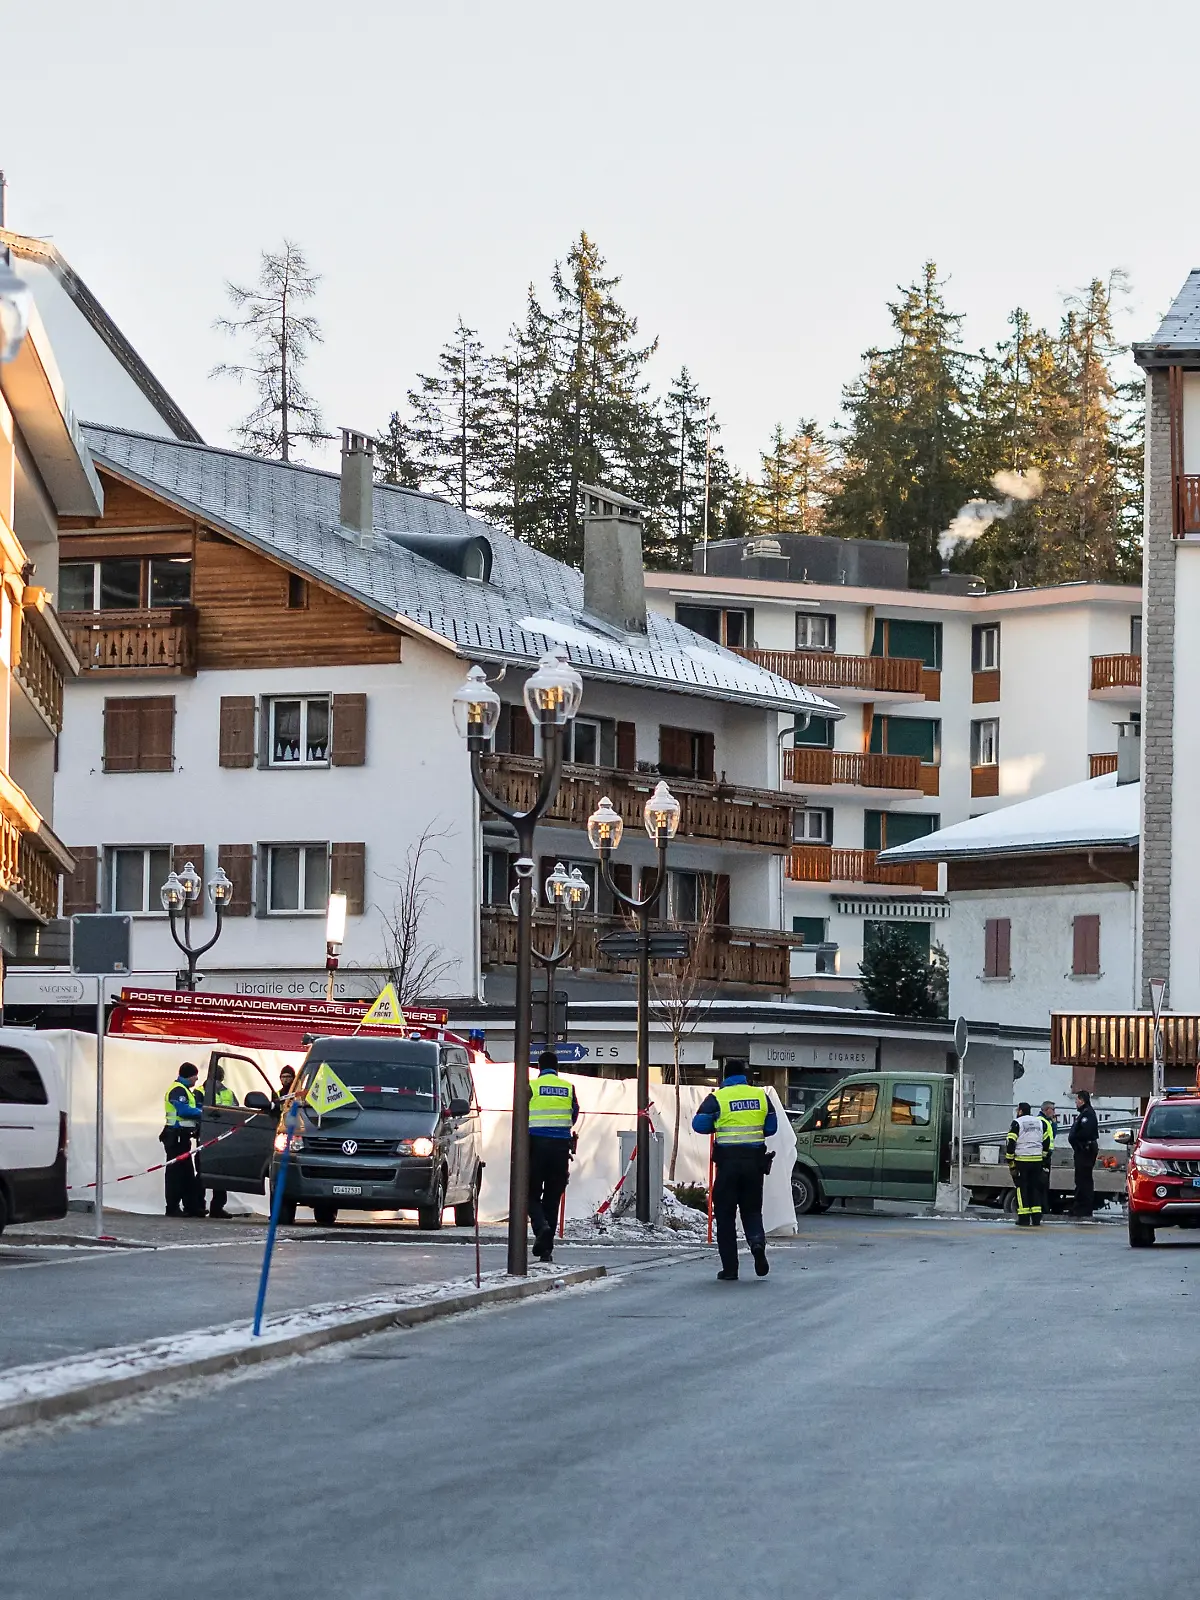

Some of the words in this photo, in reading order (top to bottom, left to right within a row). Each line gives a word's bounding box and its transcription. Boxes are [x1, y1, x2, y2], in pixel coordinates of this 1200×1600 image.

[236, 982, 284, 994] Librairie
[287, 982, 305, 994] de
[129, 992, 172, 1003] POSTE
[174, 995, 192, 1004] DE
[194, 997, 307, 1013] COMMANDEMENT
[379, 1002, 390, 1011] PC
[828, 1052, 867, 1062] CIGARES
[327, 1083, 338, 1095] PC
[540, 1086, 568, 1096] POLICE
[326, 1091, 344, 1103] FRONT
[731, 1099, 759, 1111] POLICE
